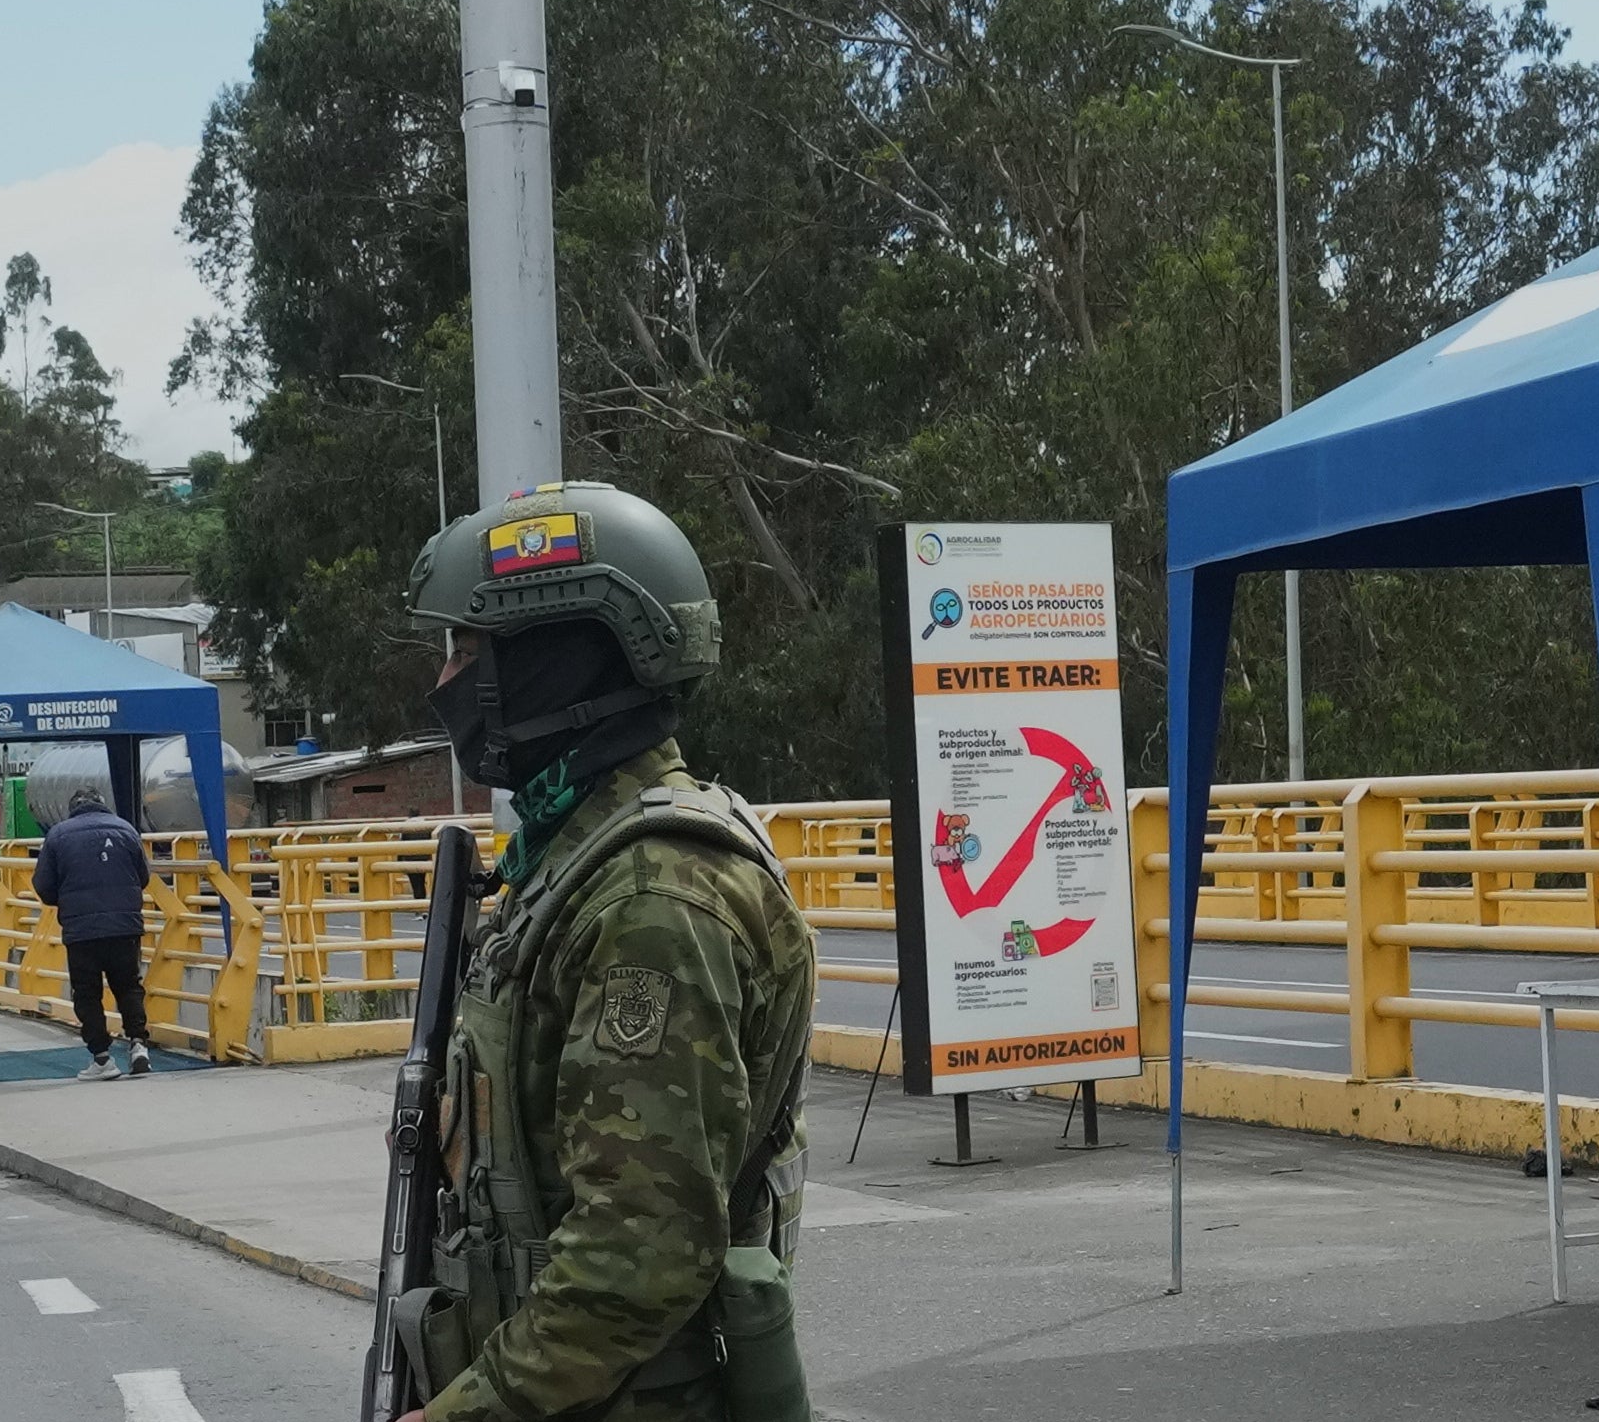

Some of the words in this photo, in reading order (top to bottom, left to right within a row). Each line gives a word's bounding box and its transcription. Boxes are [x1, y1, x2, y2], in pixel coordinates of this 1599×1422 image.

[1029, 584, 1105, 598] PASAJERO
[968, 600, 1009, 611] TODOS
[1012, 600, 1034, 610] LOS
[1037, 599, 1105, 610] PRODUCTOS
[970, 612, 1106, 628] AGROPECUARIOS
[1033, 631, 1049, 639] SON
[937, 665, 1011, 690] EVITE
[1016, 664, 1101, 687] TRAER:
[28, 698, 118, 717] DESINFECCIÓN
[37, 717, 54, 730] DE
[54, 715, 111, 730] CALZADO
[938, 728, 989, 738] Productos
[991, 729, 997, 739] y
[938, 738, 1006, 749] subproductos
[939, 750, 952, 759] de
[955, 749, 987, 760] origen
[989, 747, 1024, 757] animal:
[1044, 819, 1090, 828] Productos
[1045, 828, 1106, 840] subproductos
[1108, 826, 1118, 836] de
[1046, 839, 1075, 850] origen
[1077, 837, 1112, 849] vegetal:
[954, 959, 995, 970] Insumos
[954, 967, 1028, 982] agropecuarios:
[947, 1048, 979, 1068] SIN
[985, 1033, 1125, 1065] AUTORIZACIÓN
